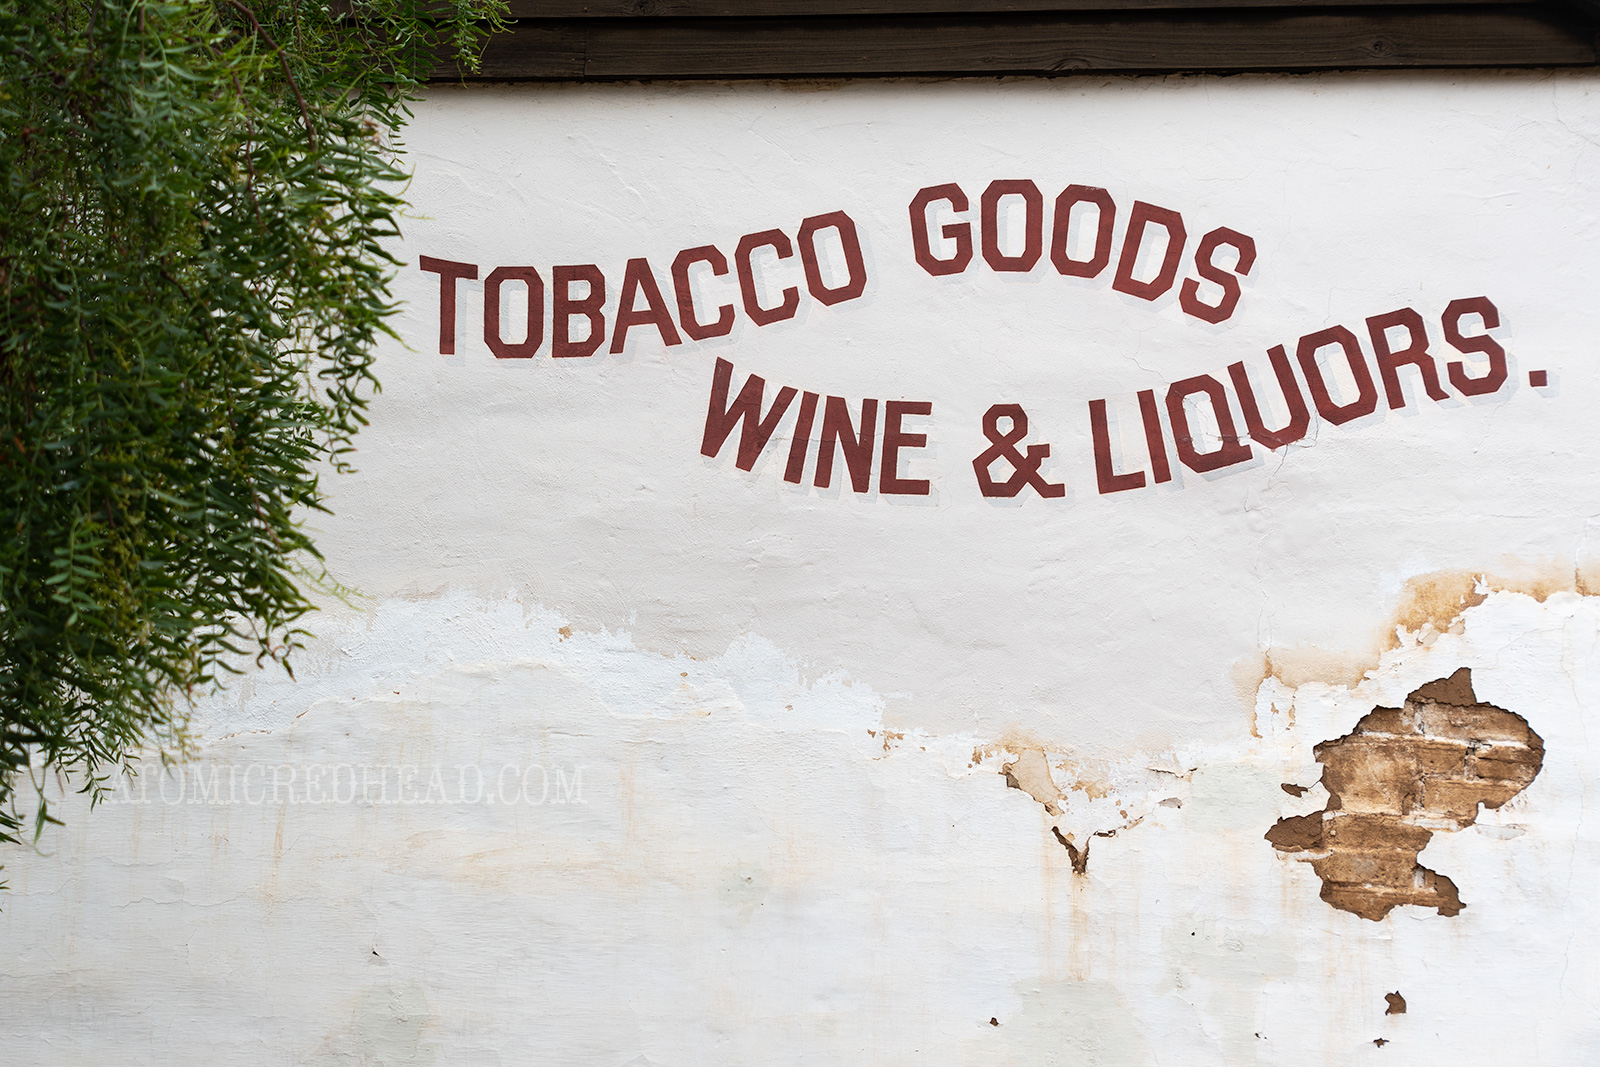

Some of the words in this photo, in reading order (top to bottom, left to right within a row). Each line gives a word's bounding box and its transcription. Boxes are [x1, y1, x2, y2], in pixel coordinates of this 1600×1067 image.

[420, 210, 866, 358] TOBACCO
[909, 180, 1256, 324] GOODS
[701, 357, 932, 495] WINE
[972, 404, 1065, 498] &
[1089, 297, 1545, 494] LIQUORS.
